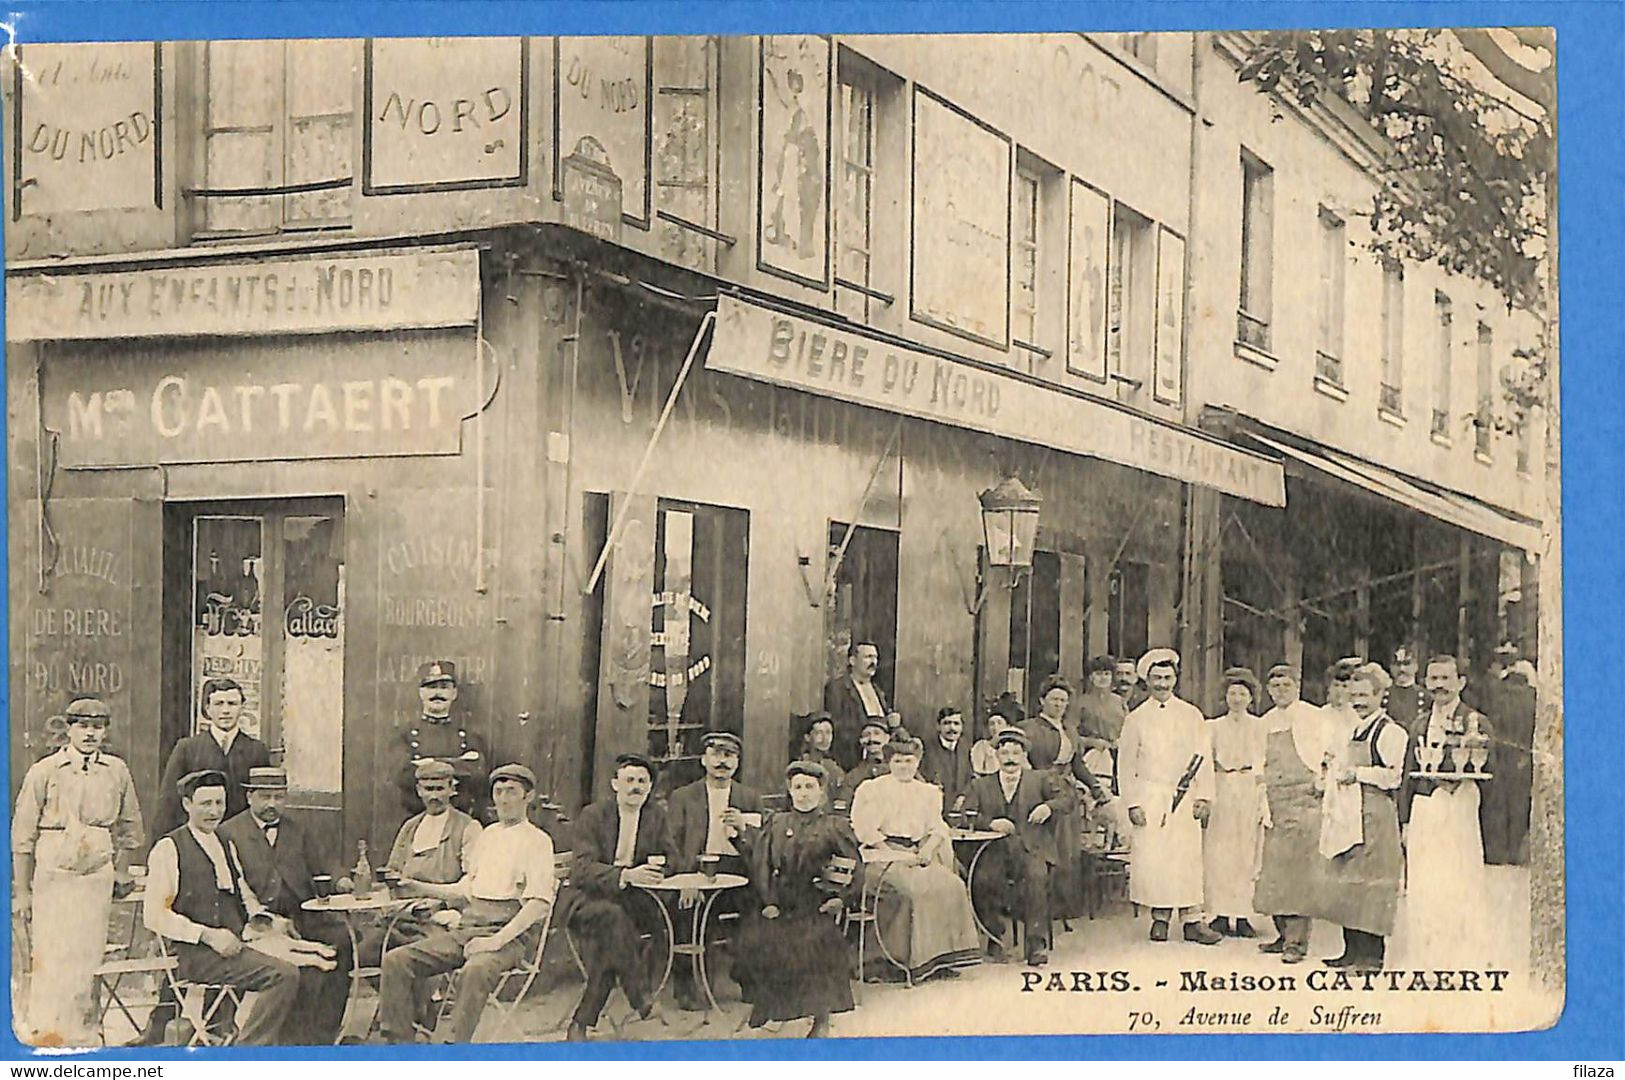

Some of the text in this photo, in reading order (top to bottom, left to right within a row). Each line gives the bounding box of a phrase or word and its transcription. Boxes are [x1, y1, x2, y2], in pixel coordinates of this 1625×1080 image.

[379, 86, 512, 135] NORD
[27, 111, 150, 163] DU NORD
[314, 264, 393, 317] NORD
[150, 373, 454, 439] CATTAERT
[882, 352, 919, 395] DU
[930, 359, 1001, 419] NORD
[1130, 419, 1262, 488] RESTAURANT
[35, 608, 57, 636] DE
[68, 661, 123, 694] NORD
